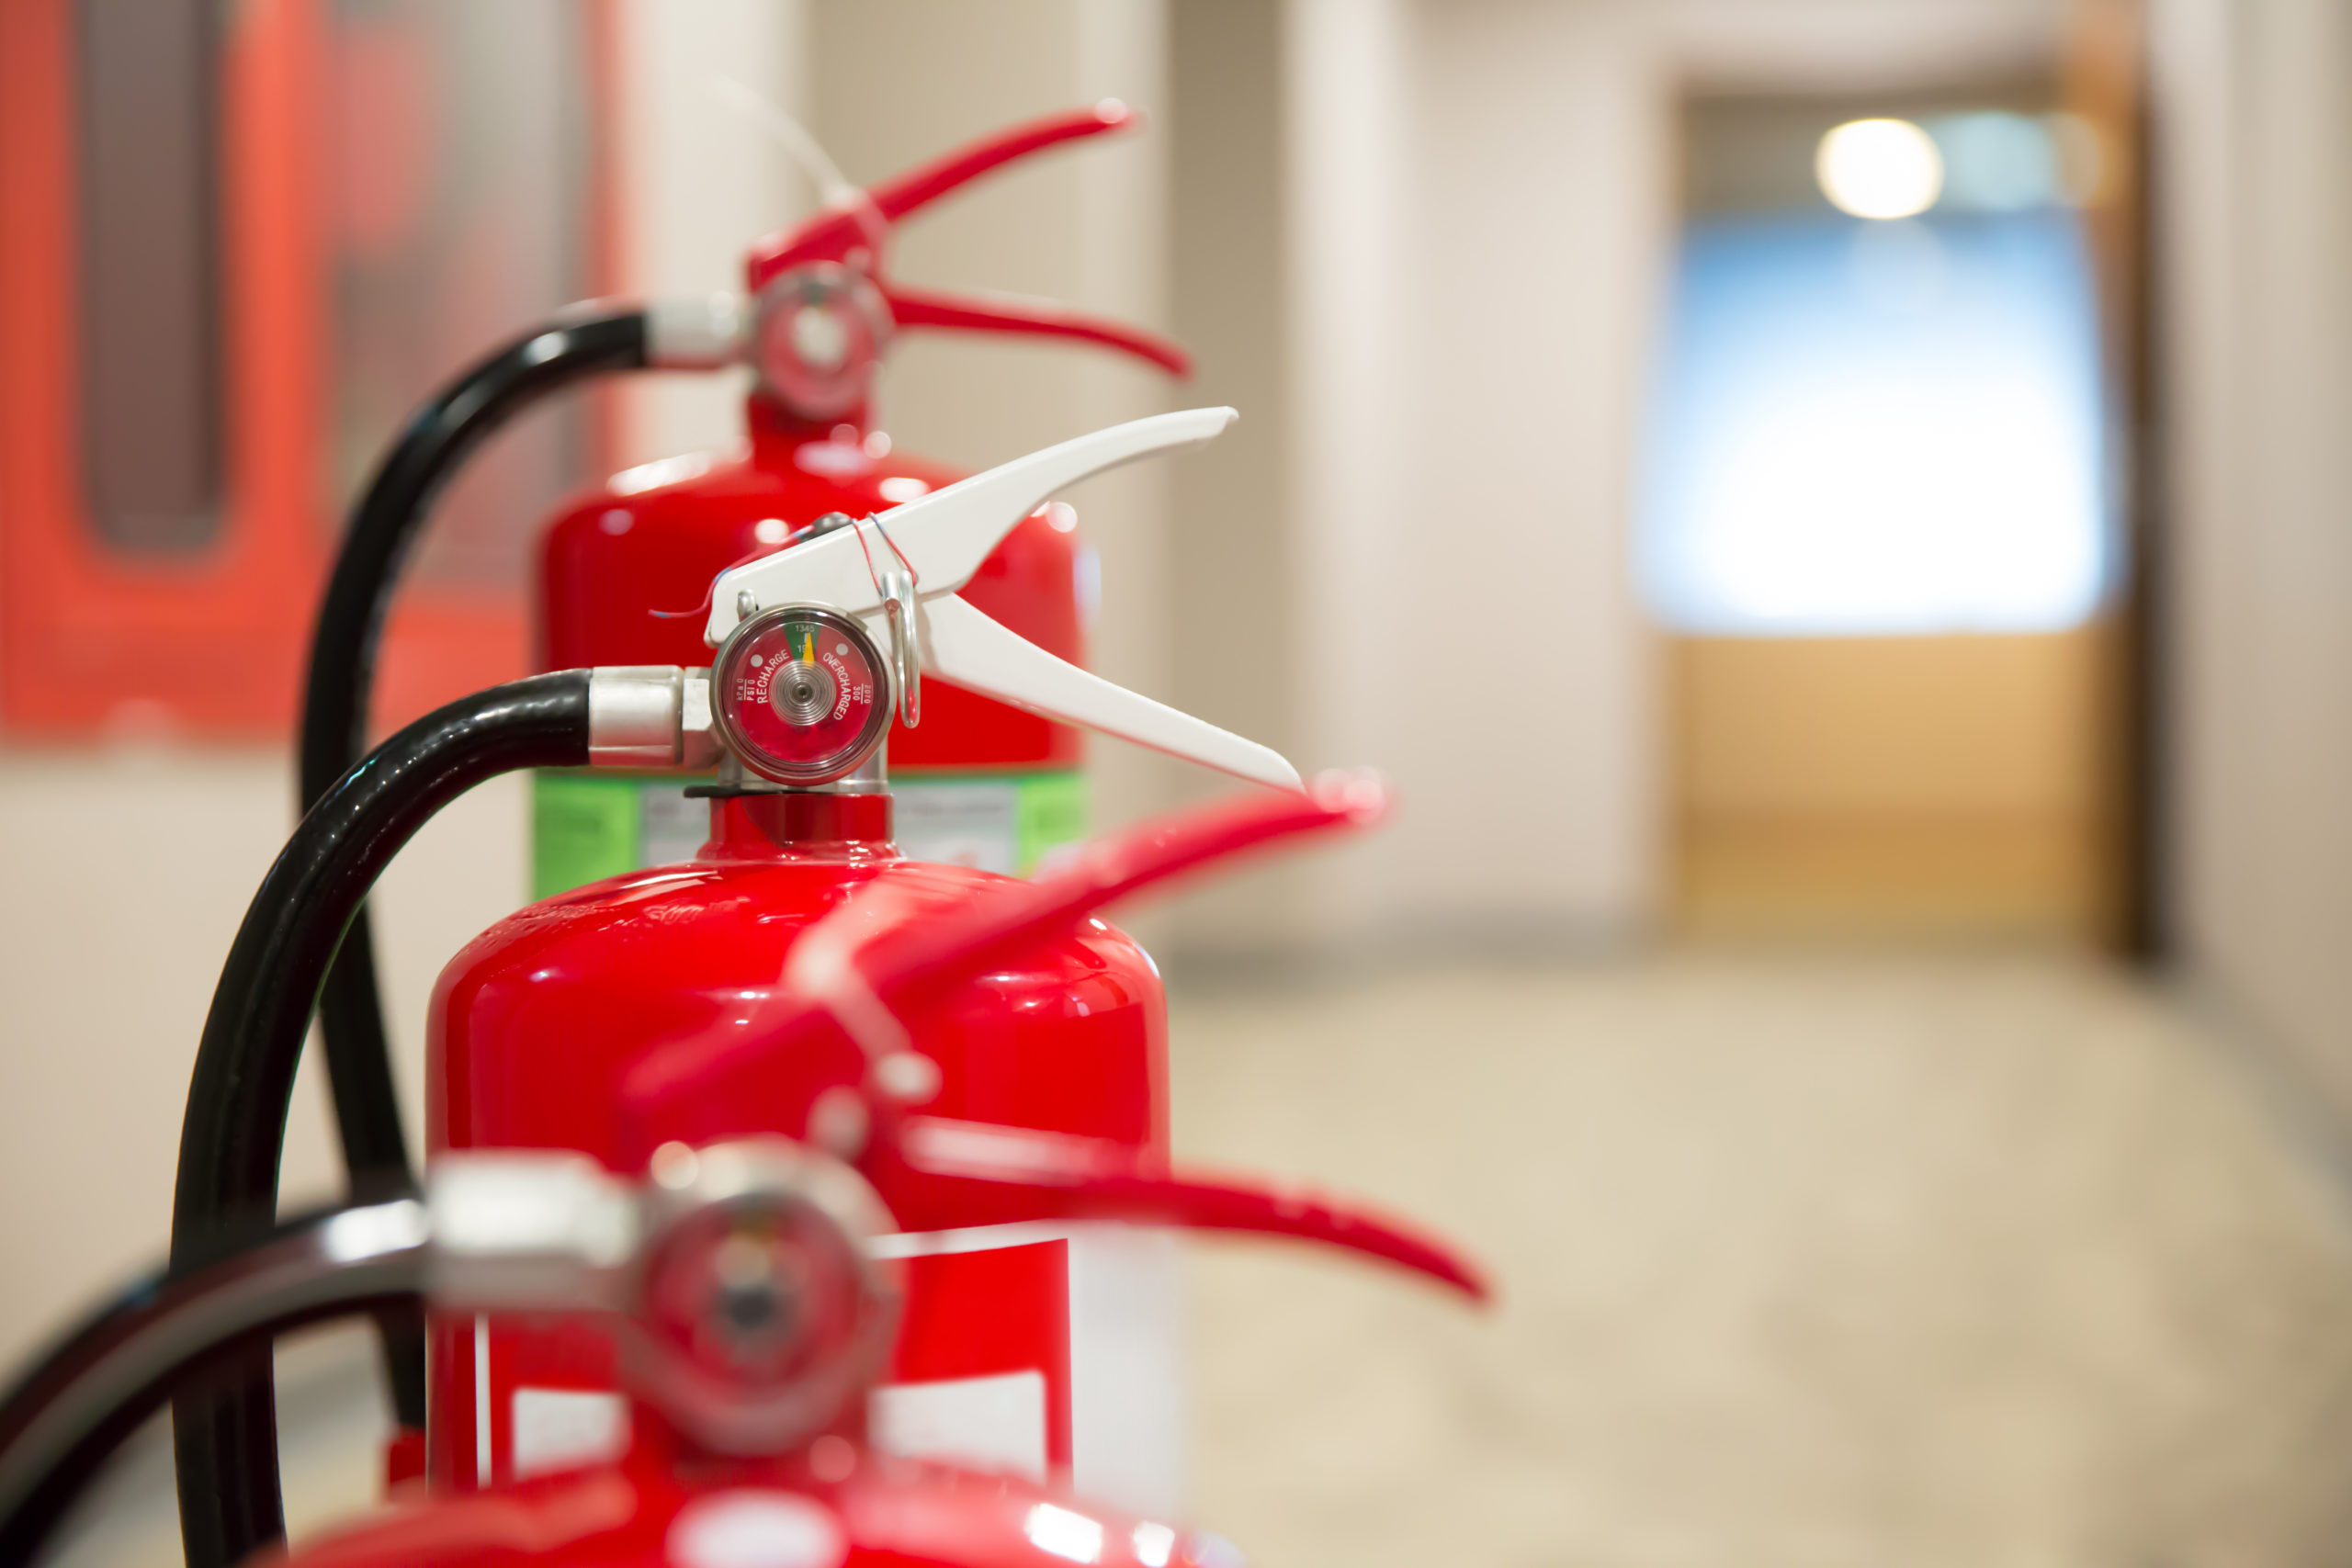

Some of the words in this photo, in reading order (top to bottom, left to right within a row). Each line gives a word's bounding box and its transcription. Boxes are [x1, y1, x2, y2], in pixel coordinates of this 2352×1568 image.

[795, 625, 815, 633] 1345
[746, 687, 755, 701] PSI
[756, 649, 790, 705] RECHARGE
[822, 651, 852, 721] OVERCHARGED
